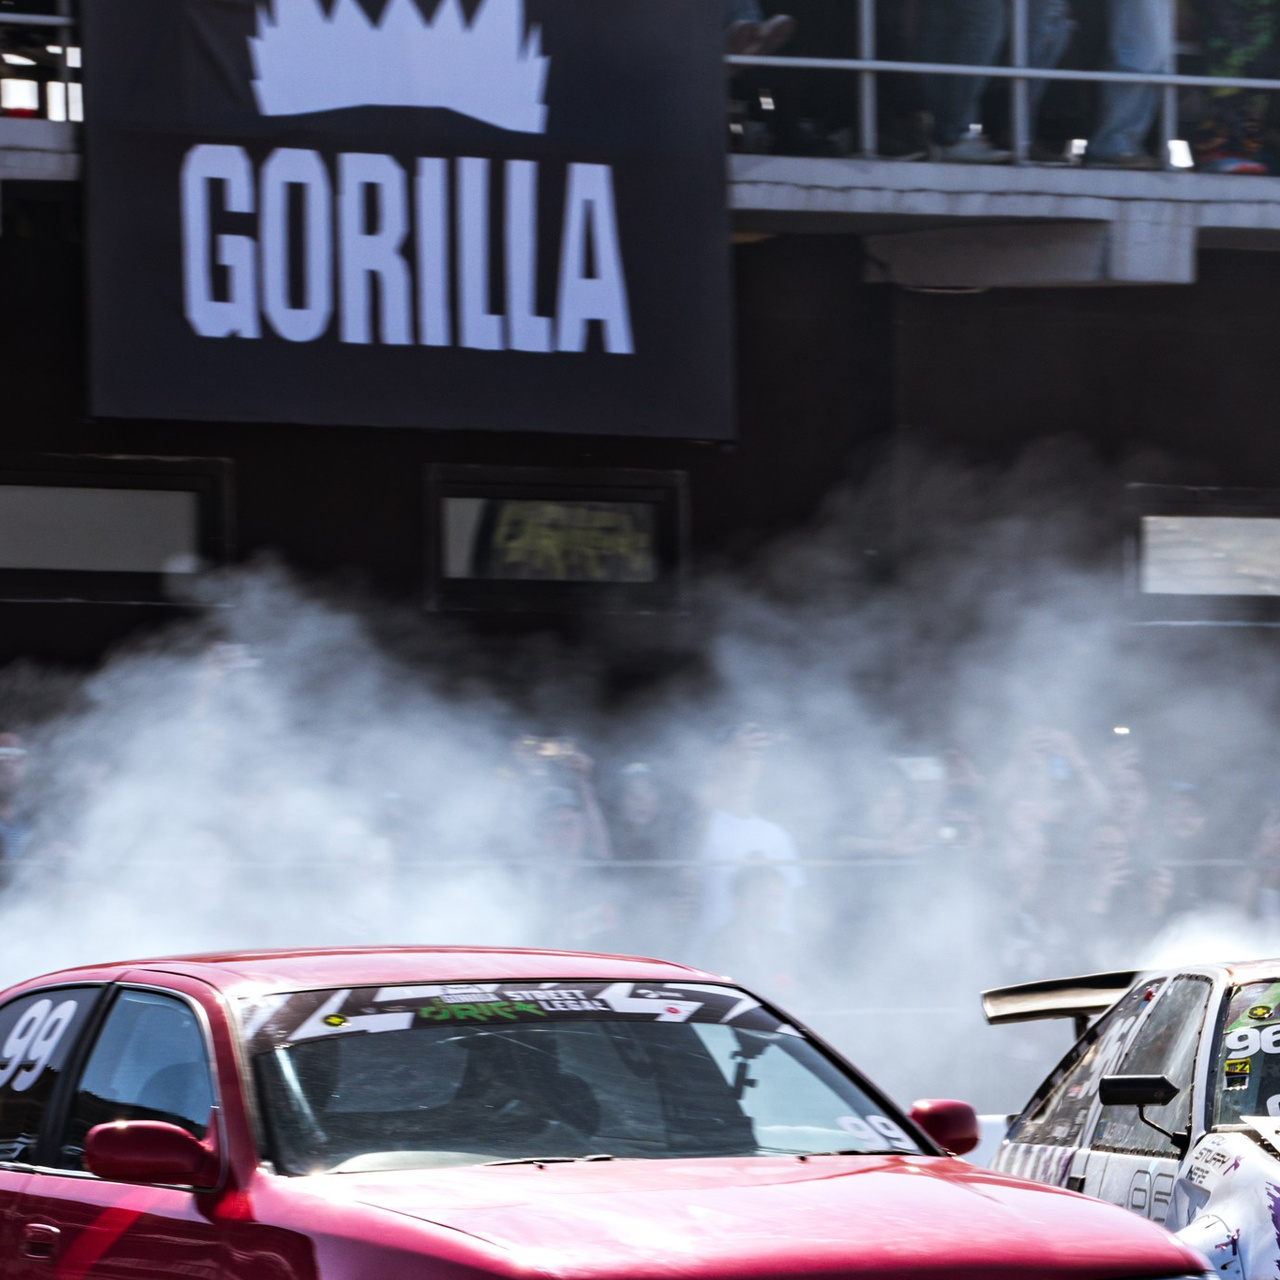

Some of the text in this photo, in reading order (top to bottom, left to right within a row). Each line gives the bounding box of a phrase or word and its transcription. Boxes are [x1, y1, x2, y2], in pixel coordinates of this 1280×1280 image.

[180, 143, 635, 354] GORILLA
[503, 989, 587, 1001] STREET
[0, 999, 78, 1091] 99
[836, 1115, 919, 1150] 99
[1194, 1147, 1231, 1168] STUFFY
